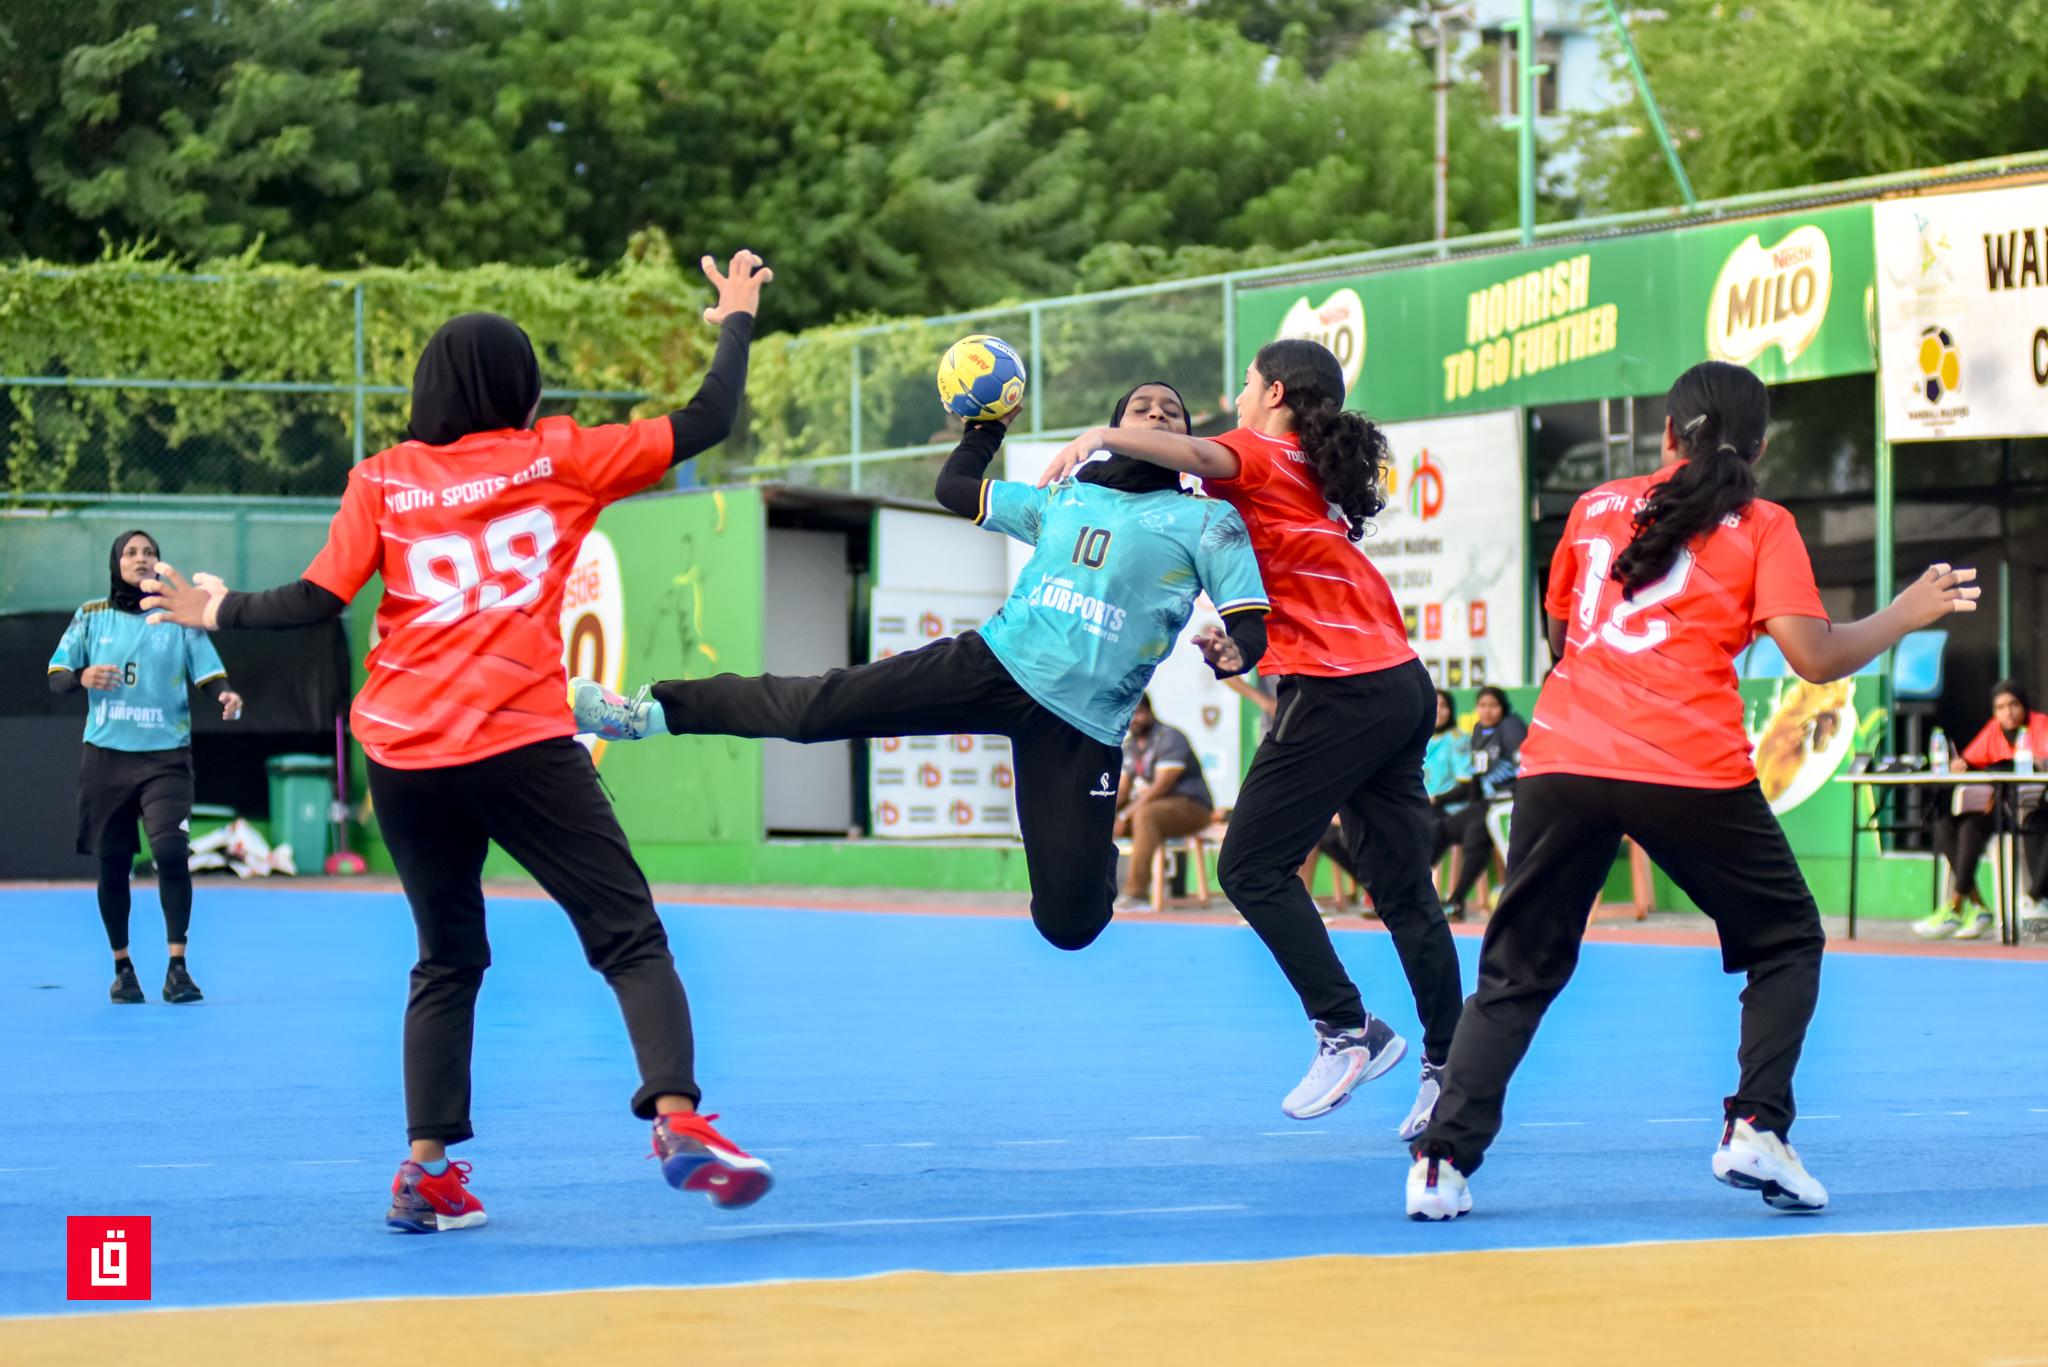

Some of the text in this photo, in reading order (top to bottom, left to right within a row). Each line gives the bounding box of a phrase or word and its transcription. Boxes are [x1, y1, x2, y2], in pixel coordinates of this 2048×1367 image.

[1983, 225, 2048, 292] WA
[1466, 254, 1591, 346] NOURISH
[1726, 266, 1817, 337] MILO
[968, 353, 990, 370] AHF
[1443, 303, 1618, 402] TO GO FURTHER
[385, 457, 553, 513] YOUTH SPORTS CLUB
[1585, 495, 1628, 520] YOUTH
[405, 505, 559, 628] 99
[1072, 526, 1112, 570] 10
[1042, 584, 1127, 631] AIRPORTS
[1579, 536, 1696, 653] 12
[124, 662, 137, 687] 6
[108, 707, 164, 722] AIRPORTS
